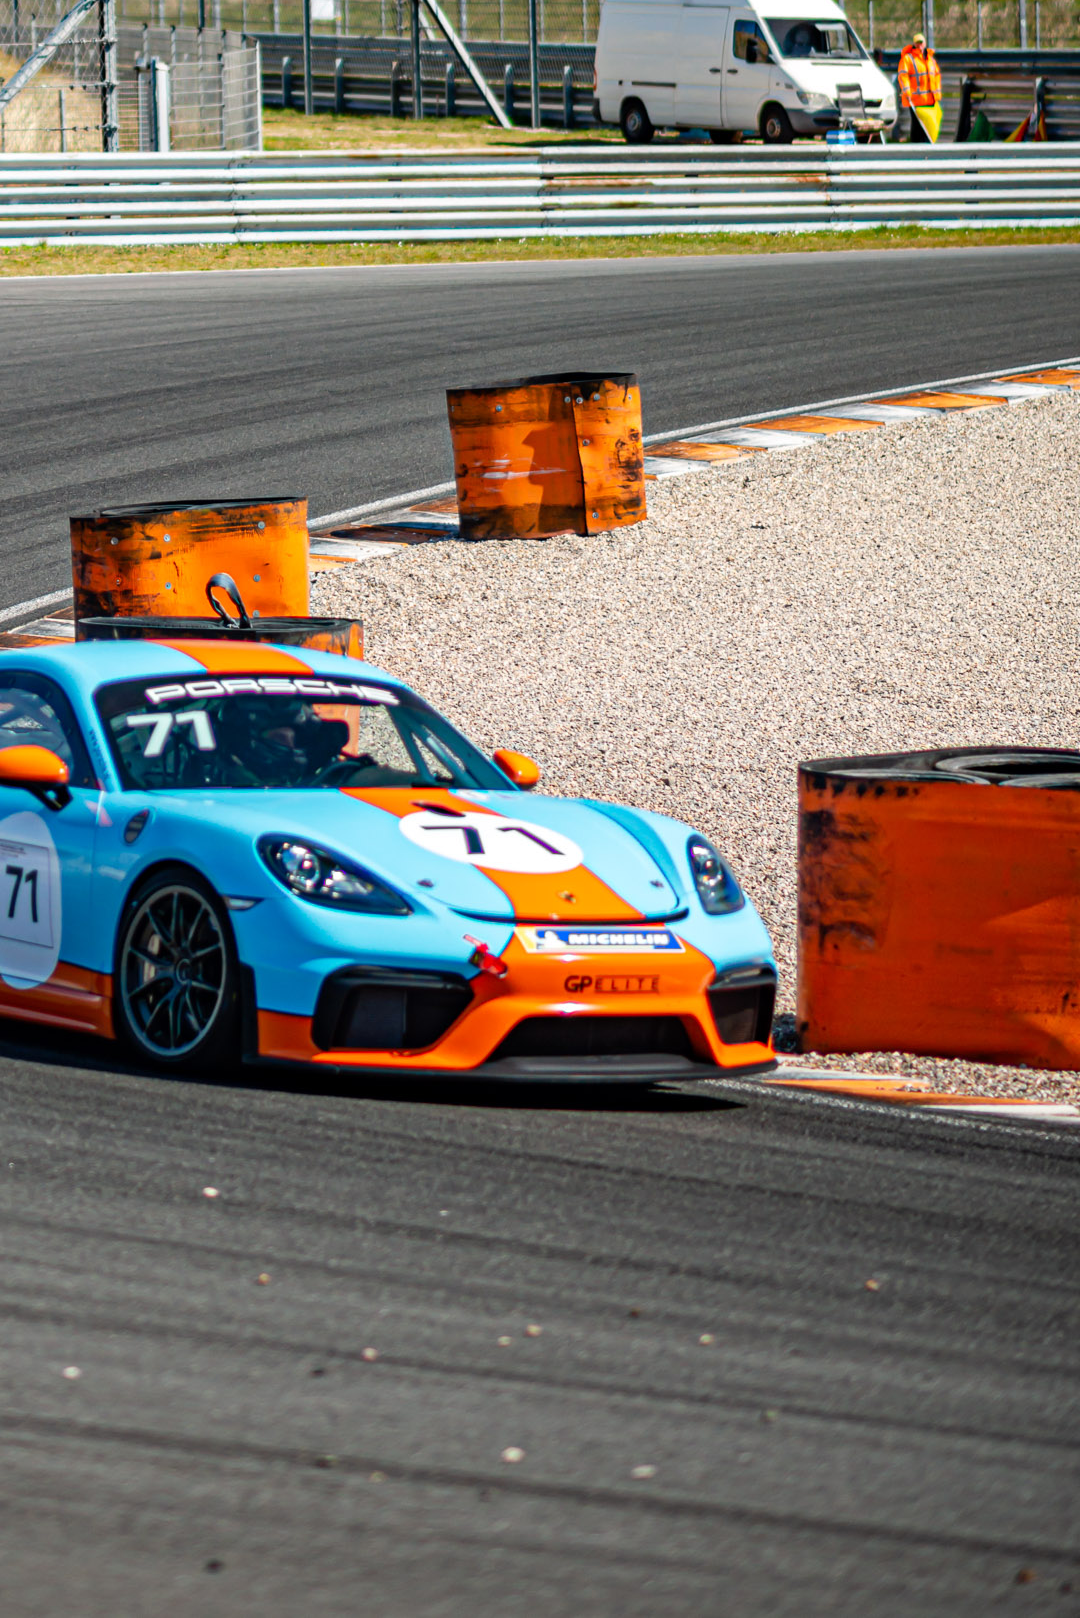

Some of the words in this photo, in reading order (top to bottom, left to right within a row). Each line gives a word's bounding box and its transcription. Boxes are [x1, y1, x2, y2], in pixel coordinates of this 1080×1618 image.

[145, 678, 400, 705] PORSCHE
[126, 710, 217, 758] 71
[420, 825, 565, 855] 71
[5, 864, 39, 923] 71
[568, 933, 670, 946] MICHELIN
